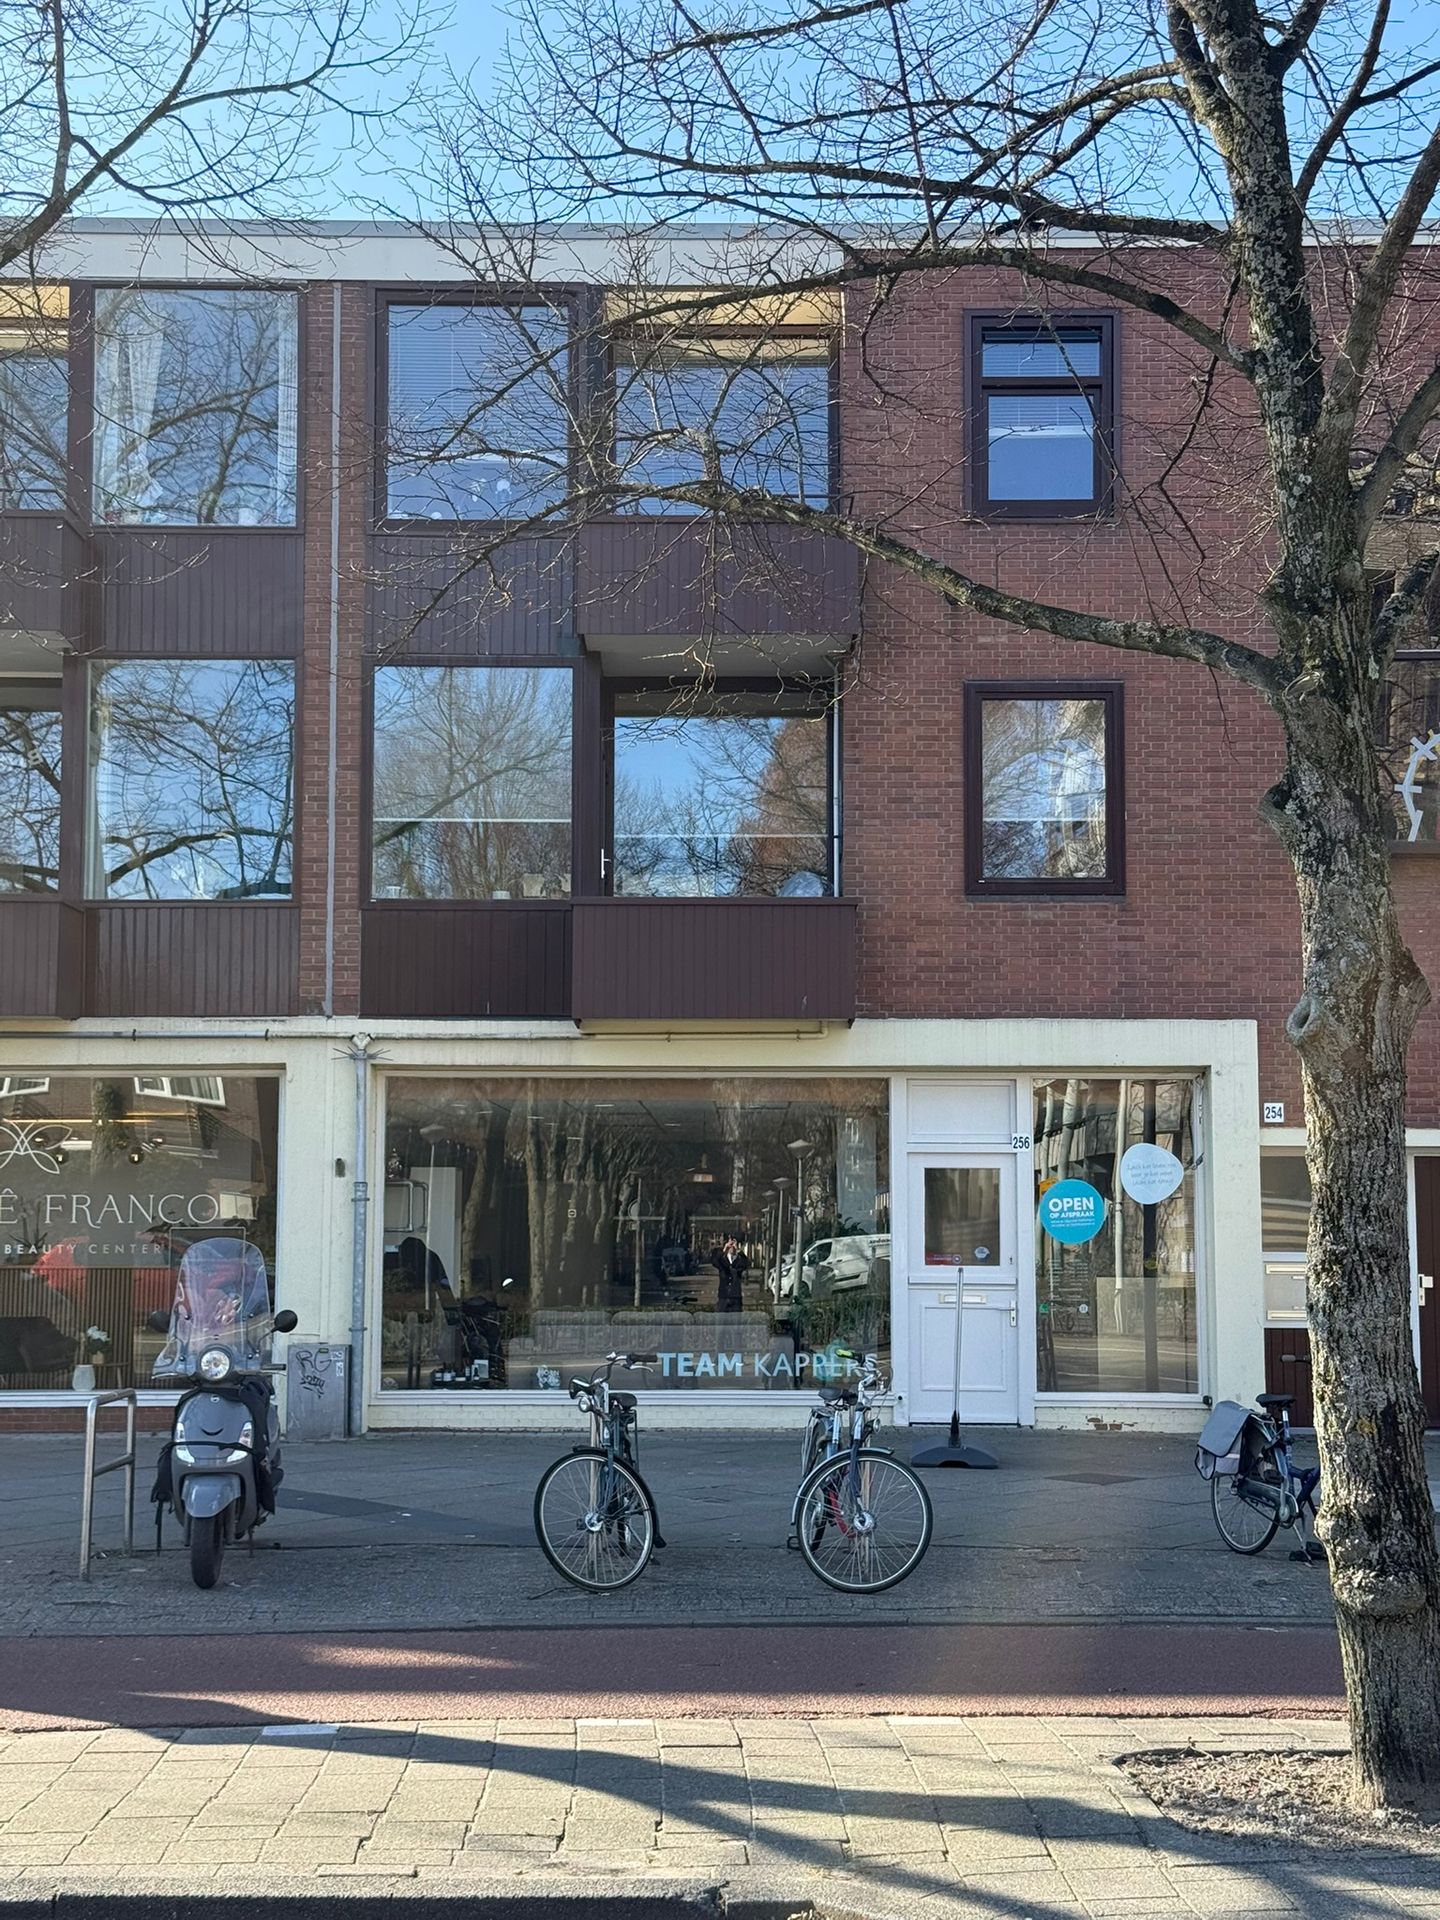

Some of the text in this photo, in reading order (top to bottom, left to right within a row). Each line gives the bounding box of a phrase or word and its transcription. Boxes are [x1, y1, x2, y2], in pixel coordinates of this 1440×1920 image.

[1265, 1106, 1282, 1119] 254
[1012, 1136, 1030, 1149] 256
[1048, 1196, 1094, 1212] OPEN
[44, 1194, 219, 1229] FRANCO
[1049, 1211, 1060, 1219] OP
[5, 1244, 161, 1255] BEAUTY CENTER
[655, 1352, 743, 1377] TEAM
